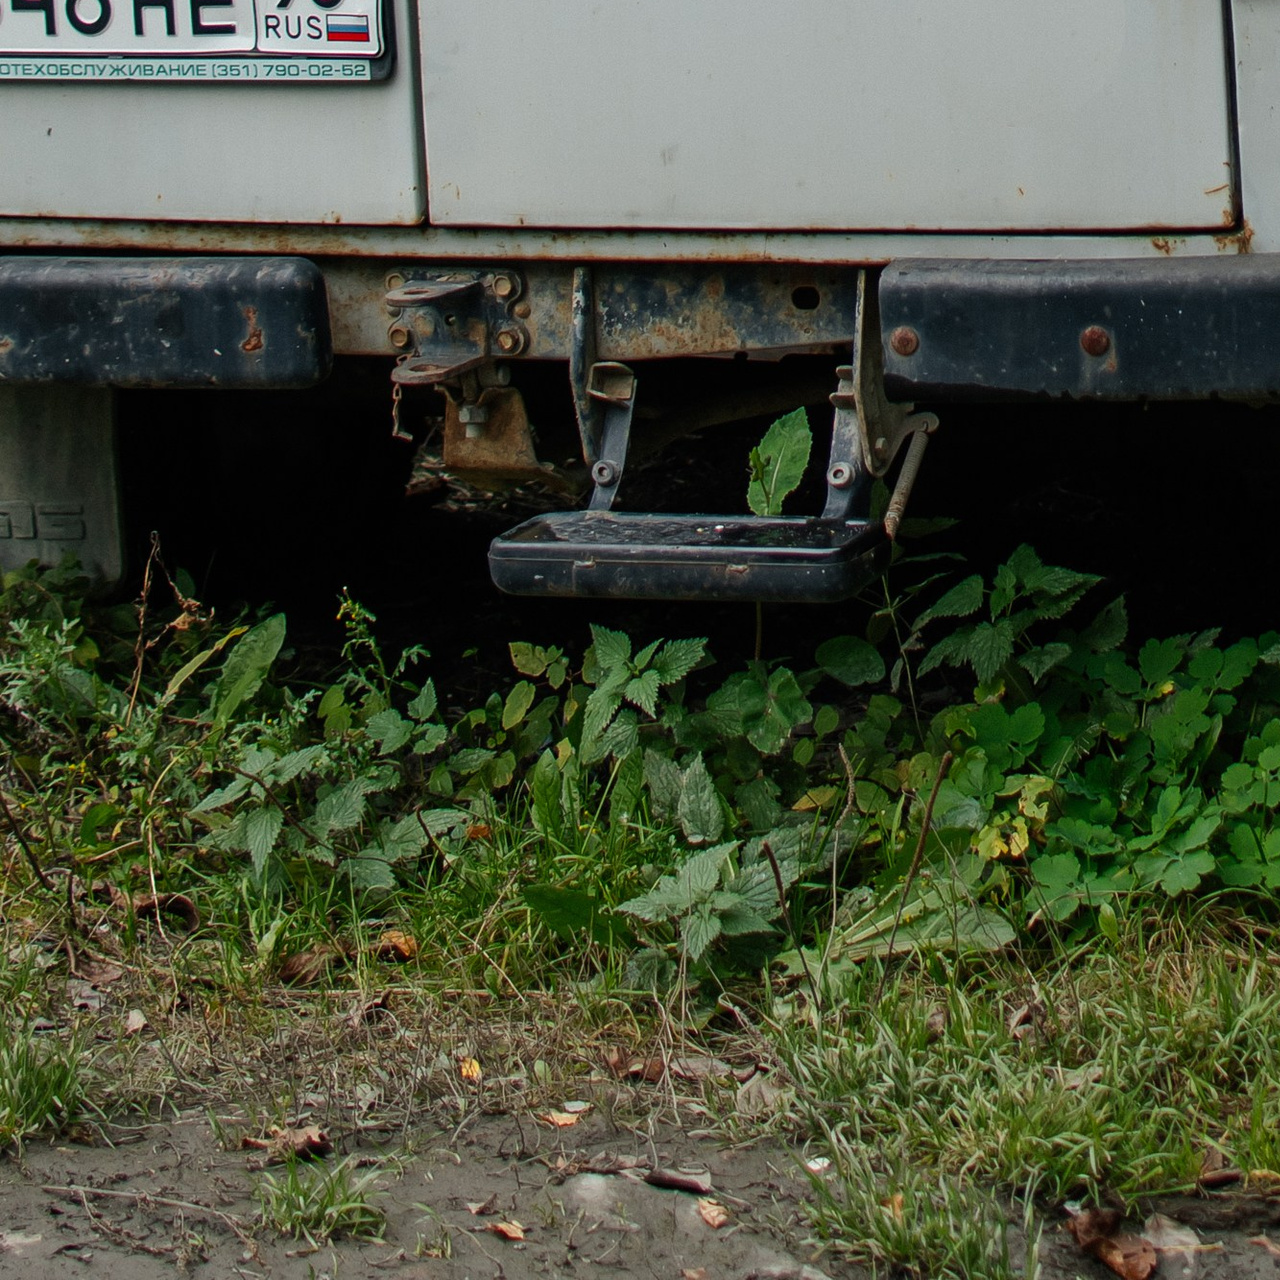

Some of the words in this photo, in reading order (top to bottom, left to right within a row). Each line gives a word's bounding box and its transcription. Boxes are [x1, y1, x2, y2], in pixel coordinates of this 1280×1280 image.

[264, 14, 323, 40] RUS
[211, 63, 258, 78] (351)
[262, 63, 367, 77] 790-02-52
